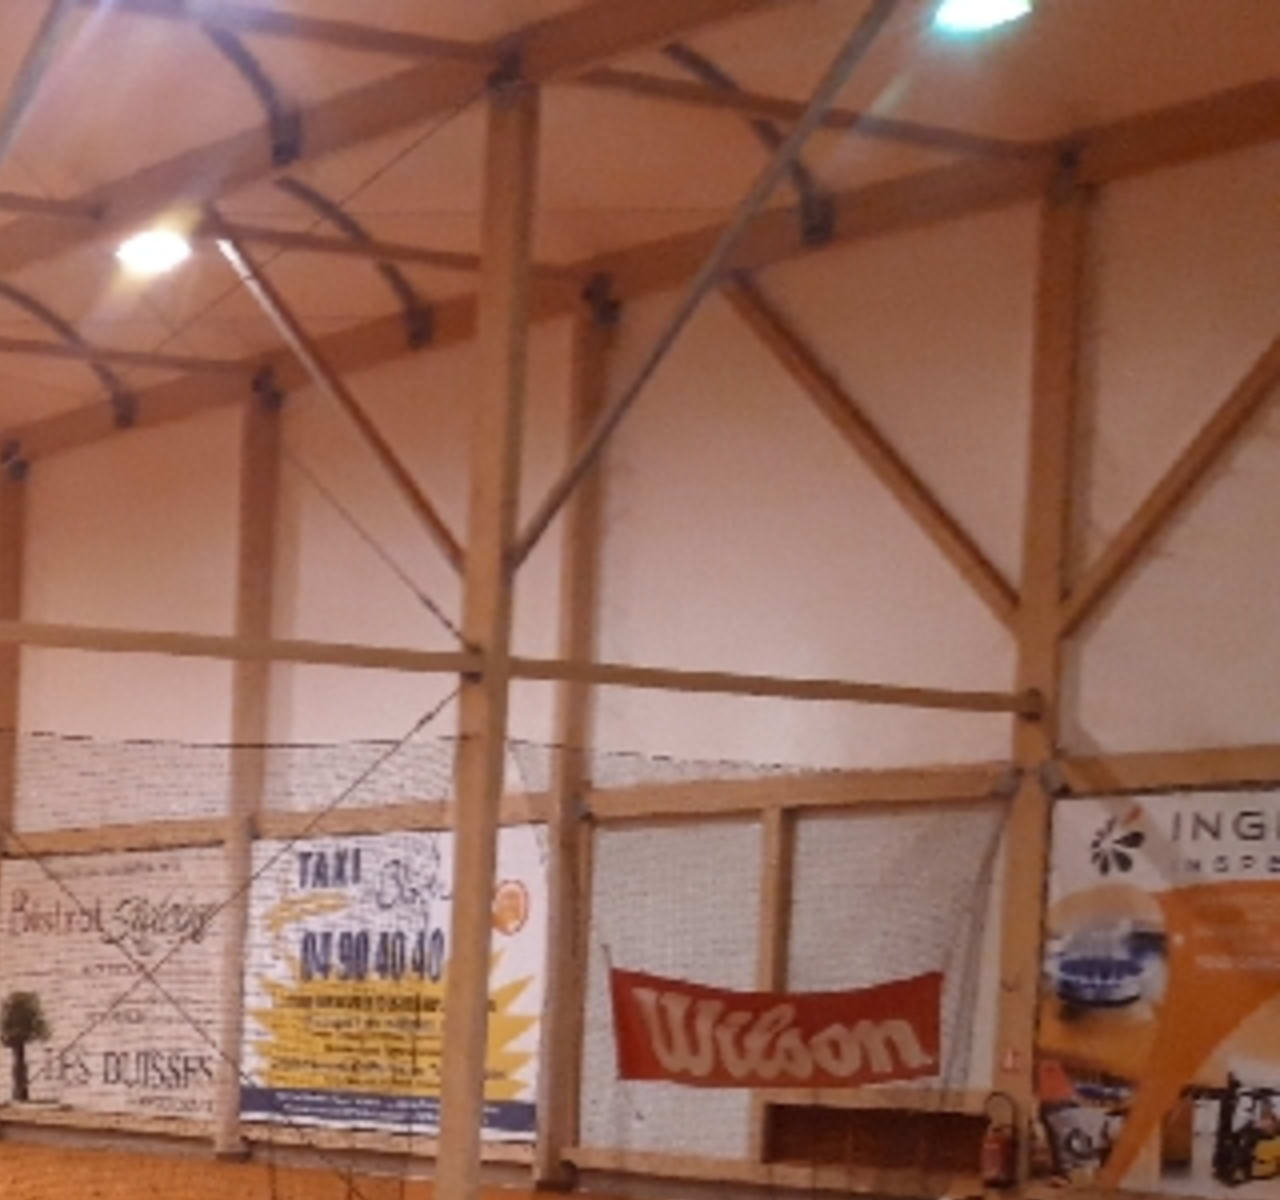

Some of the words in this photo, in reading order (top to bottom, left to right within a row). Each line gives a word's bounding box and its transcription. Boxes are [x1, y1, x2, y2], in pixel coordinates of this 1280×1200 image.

[1171, 811, 1280, 841] ING
[298, 848, 361, 888] TAXI
[631, 986, 934, 1079] Wilson
